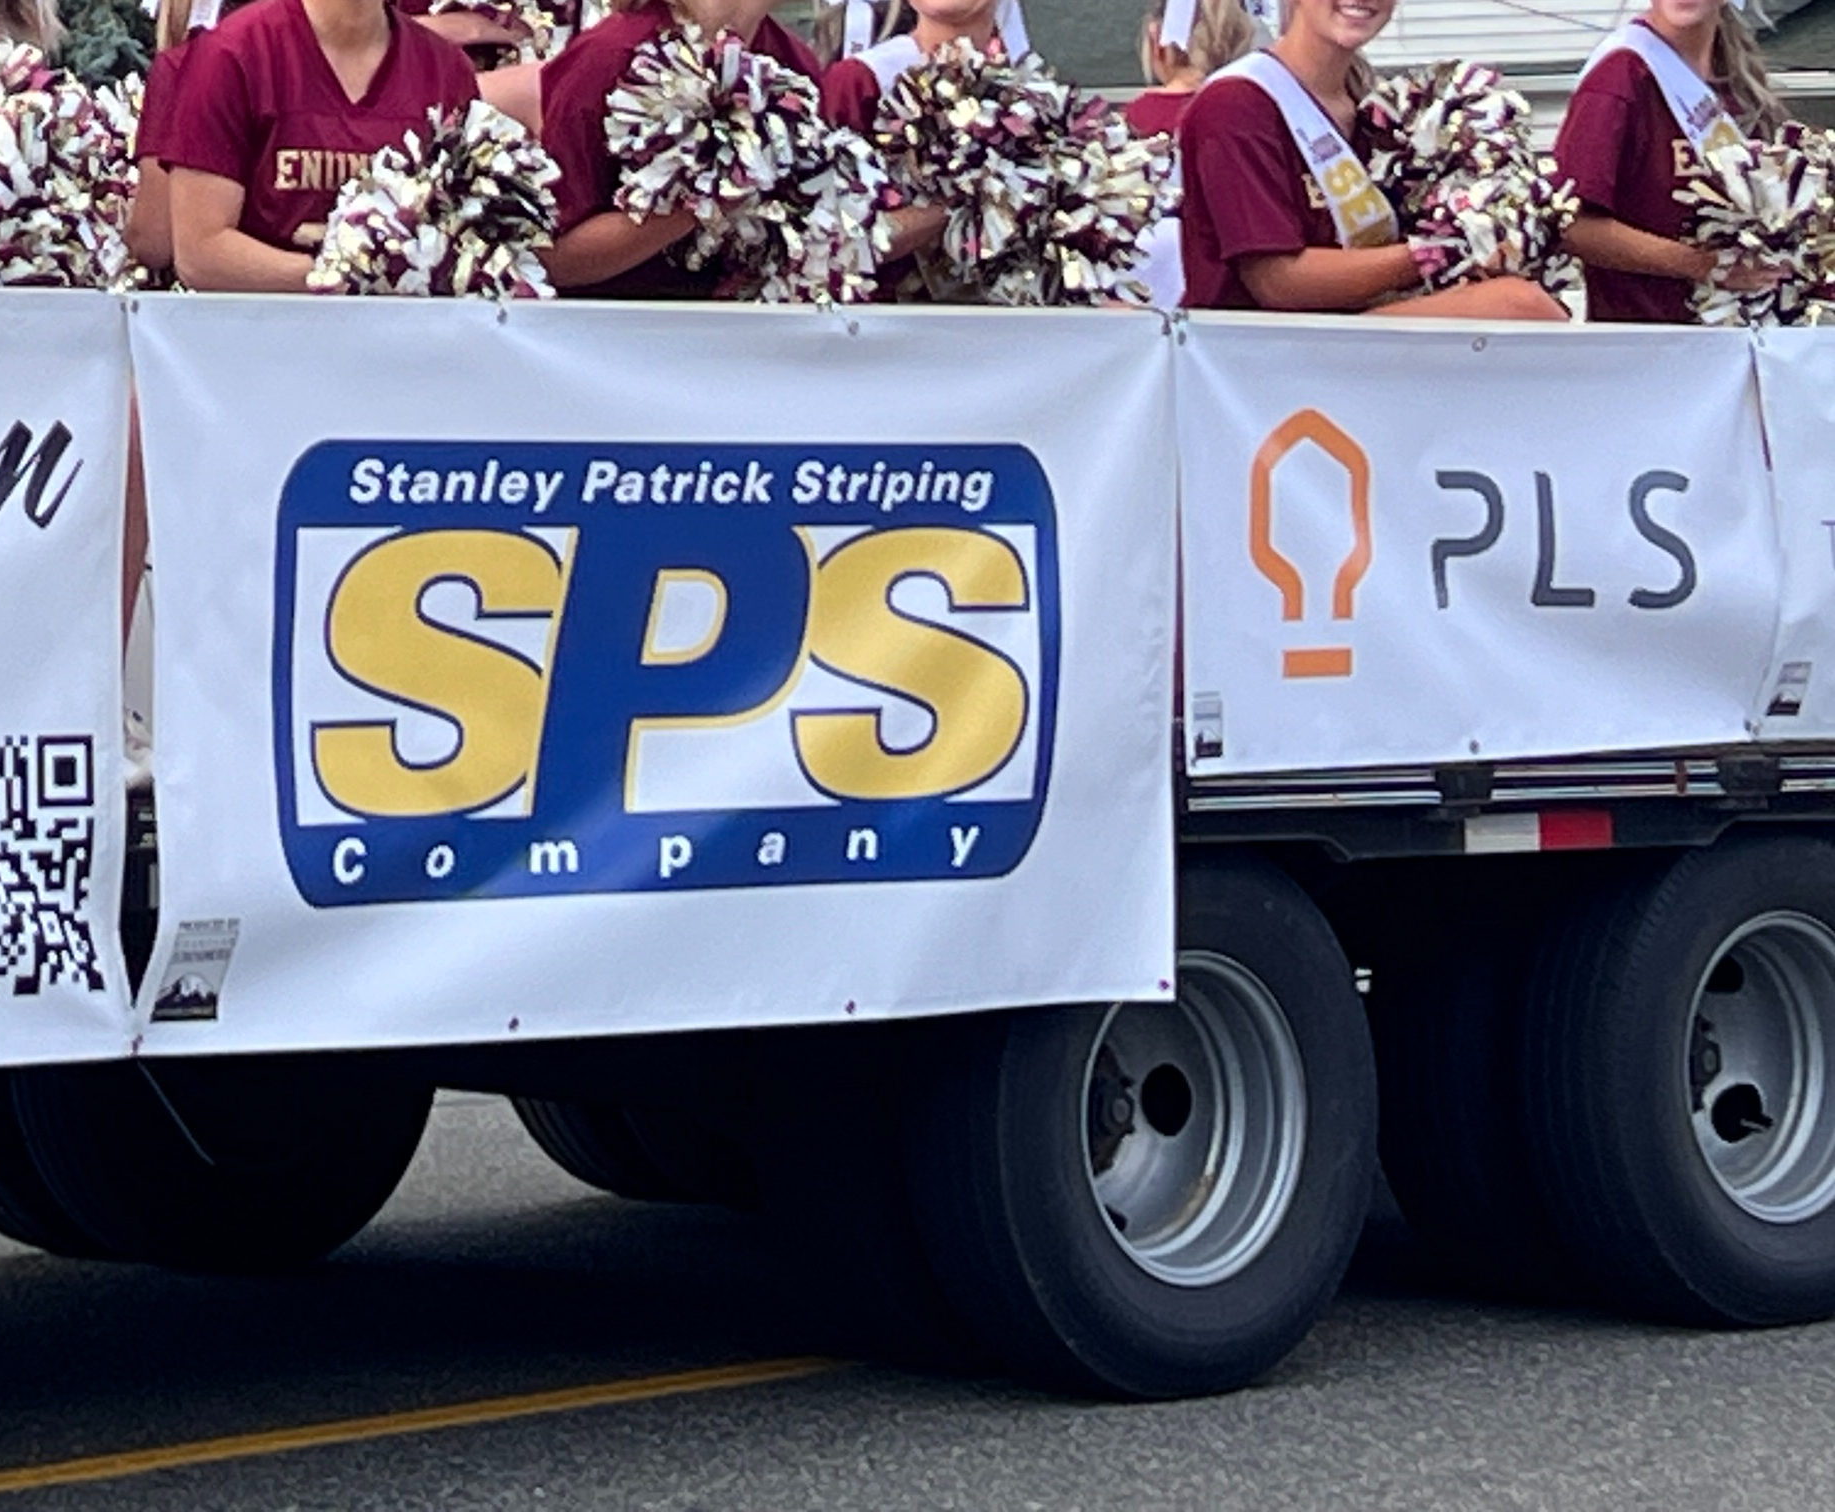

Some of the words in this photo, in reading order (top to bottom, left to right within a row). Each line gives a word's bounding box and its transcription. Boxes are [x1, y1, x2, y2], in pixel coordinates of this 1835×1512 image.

[349, 458, 564, 513] Stanley
[581, 461, 773, 504] Patrick
[791, 461, 993, 512] Striping
[1431, 469, 1697, 610] PLS
[310, 523, 1029, 817] SPS
